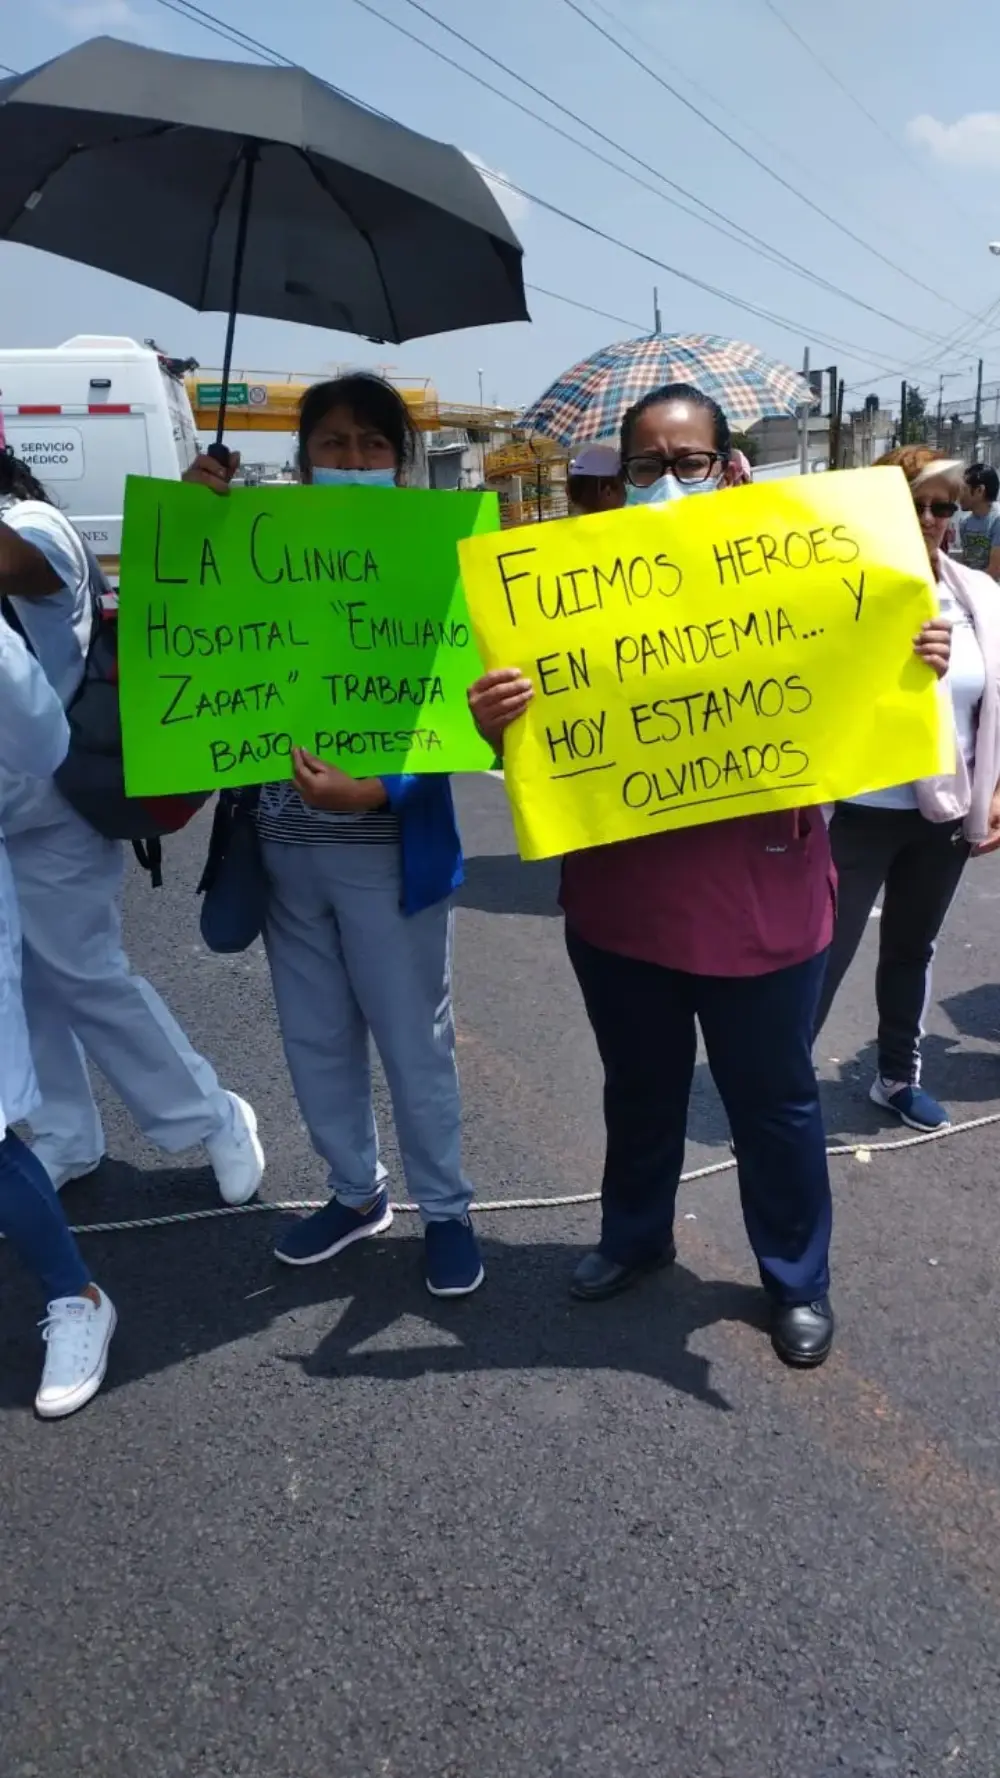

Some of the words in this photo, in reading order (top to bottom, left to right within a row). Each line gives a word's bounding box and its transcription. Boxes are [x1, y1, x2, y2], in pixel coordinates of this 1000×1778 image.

[21, 442, 75, 452] SERVICIO
[154, 502, 221, 585] LA
[250, 512, 379, 584] CLINICA
[497, 548, 683, 626] FUIMOS
[713, 525, 861, 585] HEROES
[147, 600, 309, 659] HOSPITAL
[330, 600, 469, 650] "EMILIANO
[537, 649, 590, 695] EN
[615, 607, 825, 683] PANDEMIA...
[842, 572, 865, 621] Y
[158, 669, 299, 725] ZAPATA"
[322, 674, 445, 706] TRABAJA
[546, 711, 606, 763] HOY
[631, 675, 813, 746] ESTAMOS
[209, 732, 293, 773] BAJO
[315, 729, 442, 757] PROTESTA
[622, 740, 809, 809] OLVIDADOS
